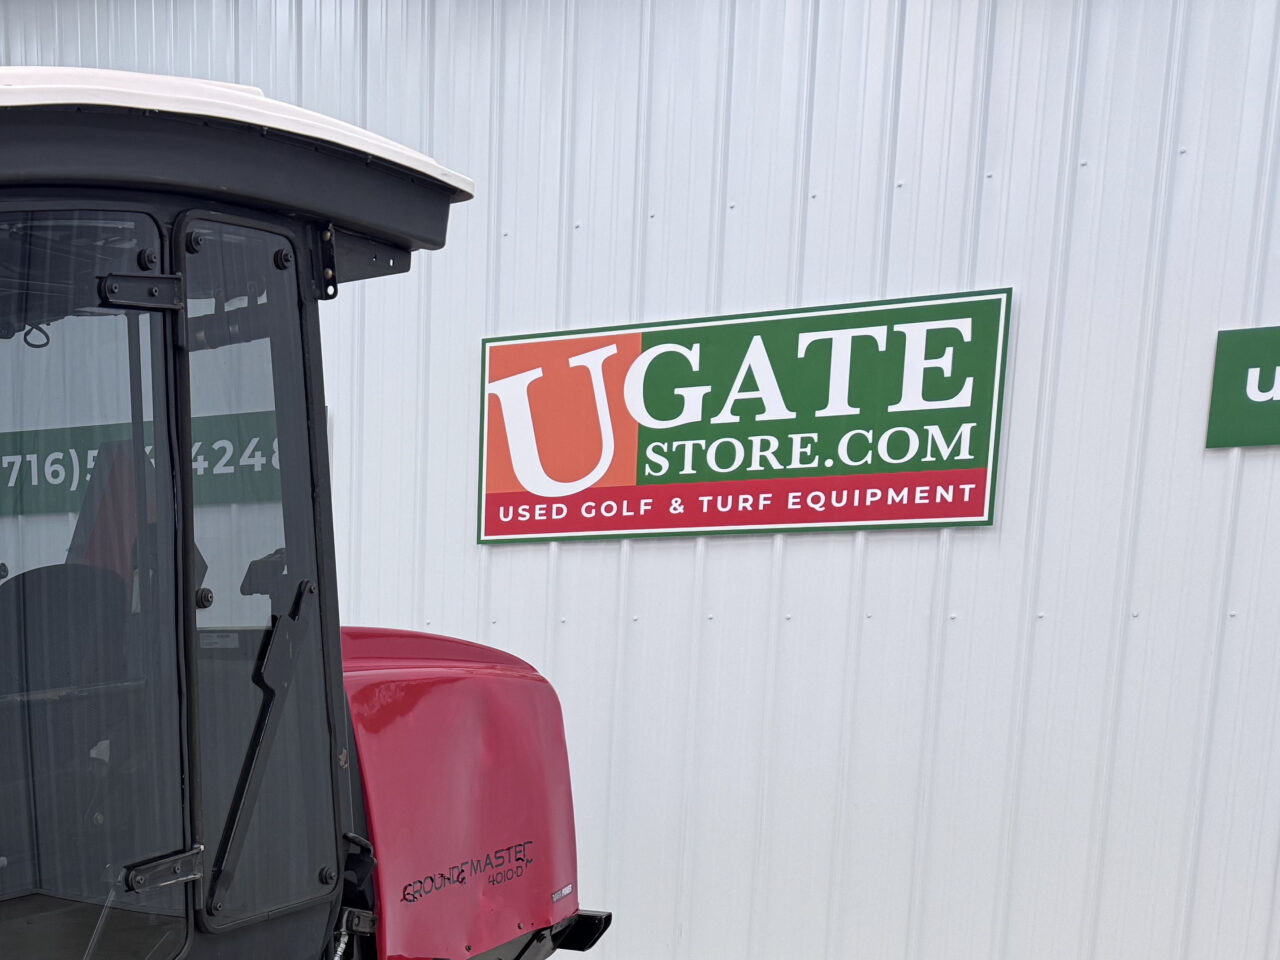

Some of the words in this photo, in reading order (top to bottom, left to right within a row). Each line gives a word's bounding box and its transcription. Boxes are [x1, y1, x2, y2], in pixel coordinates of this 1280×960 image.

[645, 422, 977, 477] STORE.COM
[499, 503, 568, 522] USED
[581, 499, 653, 518] GOLF
[669, 497, 685, 514] &
[699, 493, 773, 513] TURF
[787, 484, 976, 511] EQUIPMENT
[488, 865, 523, 885] 4010-D
